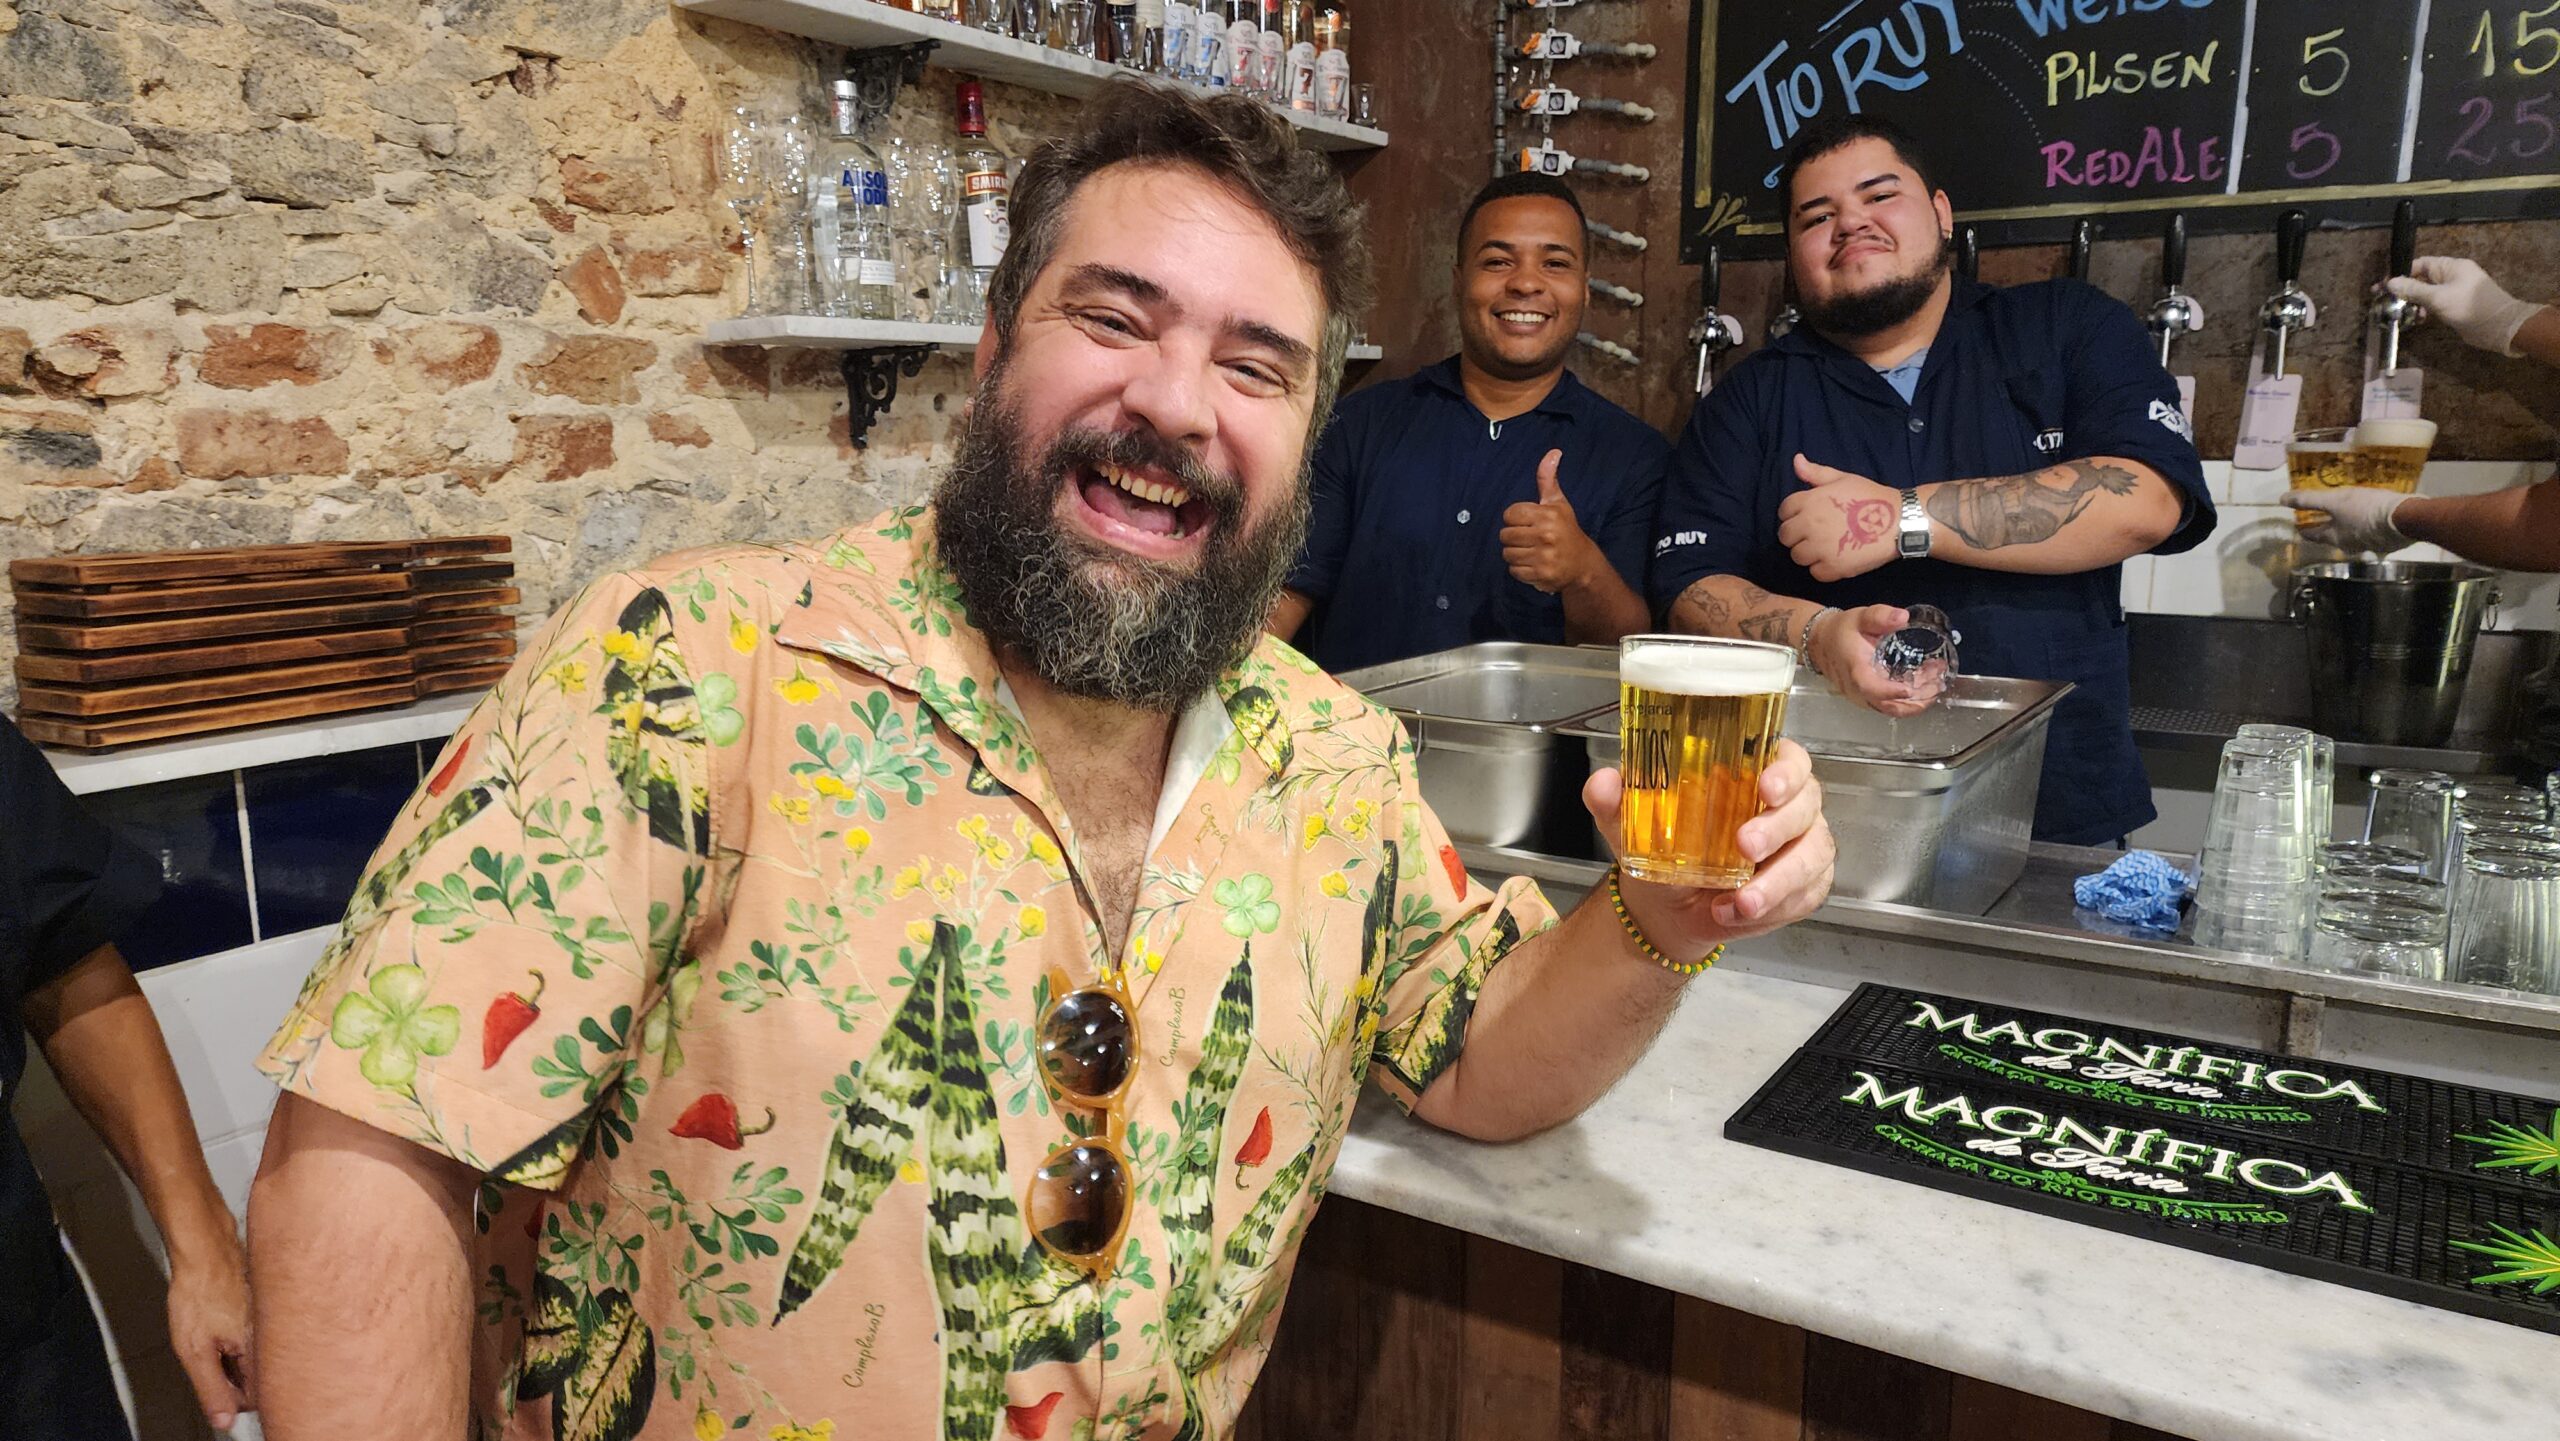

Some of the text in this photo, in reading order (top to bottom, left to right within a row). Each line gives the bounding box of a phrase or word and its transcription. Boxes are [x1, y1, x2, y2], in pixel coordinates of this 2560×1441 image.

[1725, 0, 1964, 150] TIO RUY
[2045, 3, 2560, 106] PILSEN 5 15
[2286, 121, 2341, 179] 5
[2446, 93, 2554, 167] 25
[1675, 531, 1707, 545] RUY
[1905, 1000, 2388, 1112] MAGNÍFICA
[2021, 1054, 2223, 1099] de Faria
[2044, 1079, 2084, 1094] DO
[1841, 1071, 2378, 1214] MAGNÍFICA
[1965, 1137, 2190, 1194] de Faria
[1988, 1168, 2034, 1187] DO
[2039, 1180, 2099, 1203] RIO
[2110, 1195, 2152, 1212] DE
